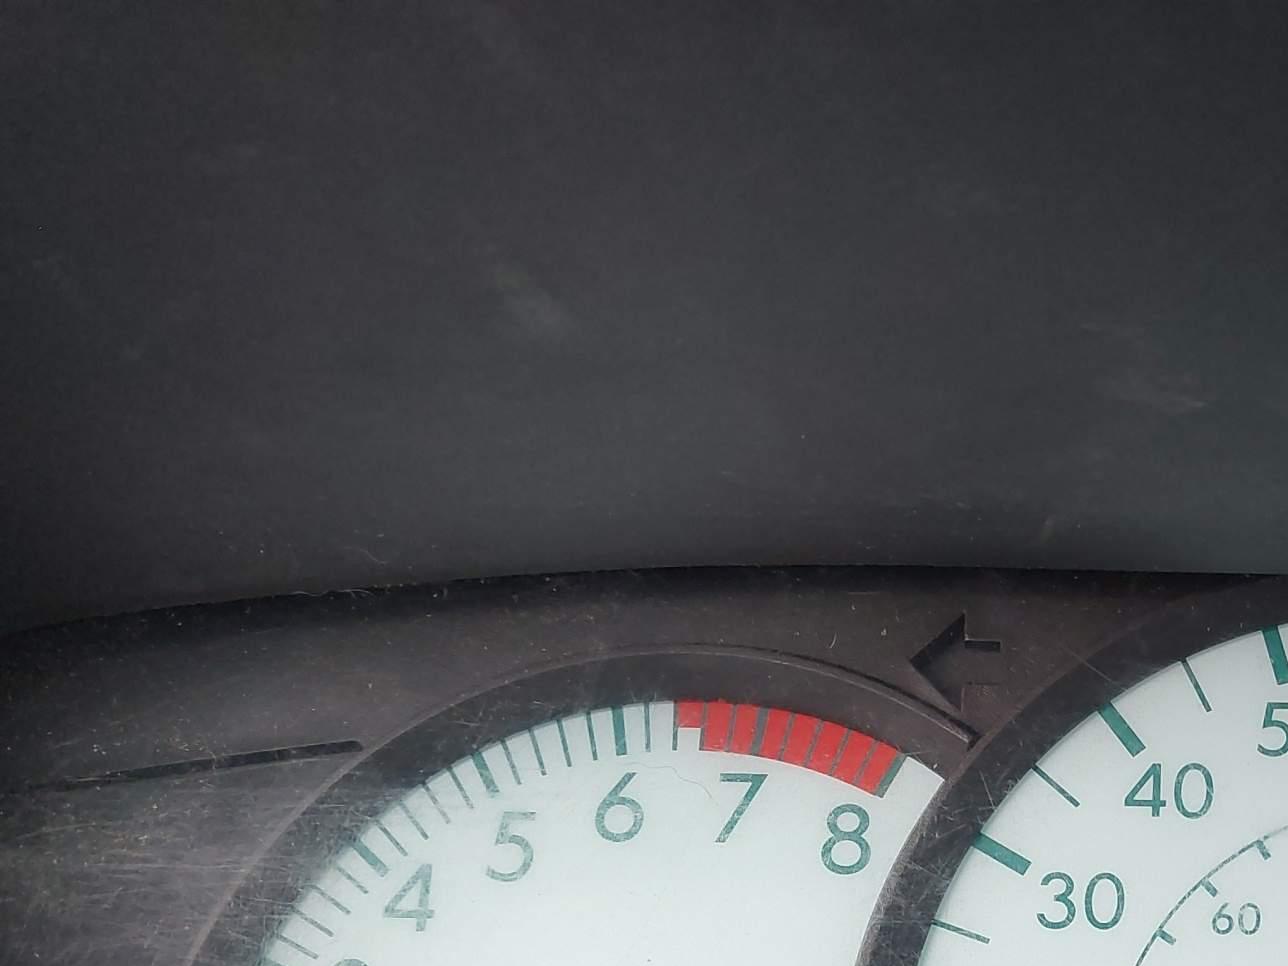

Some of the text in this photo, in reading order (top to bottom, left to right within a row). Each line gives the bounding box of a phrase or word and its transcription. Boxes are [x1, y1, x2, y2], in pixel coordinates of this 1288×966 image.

[594, 772, 646, 843] 6
[714, 773, 768, 844] 7
[1124, 763, 1215, 820] 40
[484, 810, 537, 883] 5
[820, 803, 872, 876] 8
[382, 863, 435, 932] 4
[1036, 872, 1126, 931] 30
[1211, 902, 1262, 936] 60
